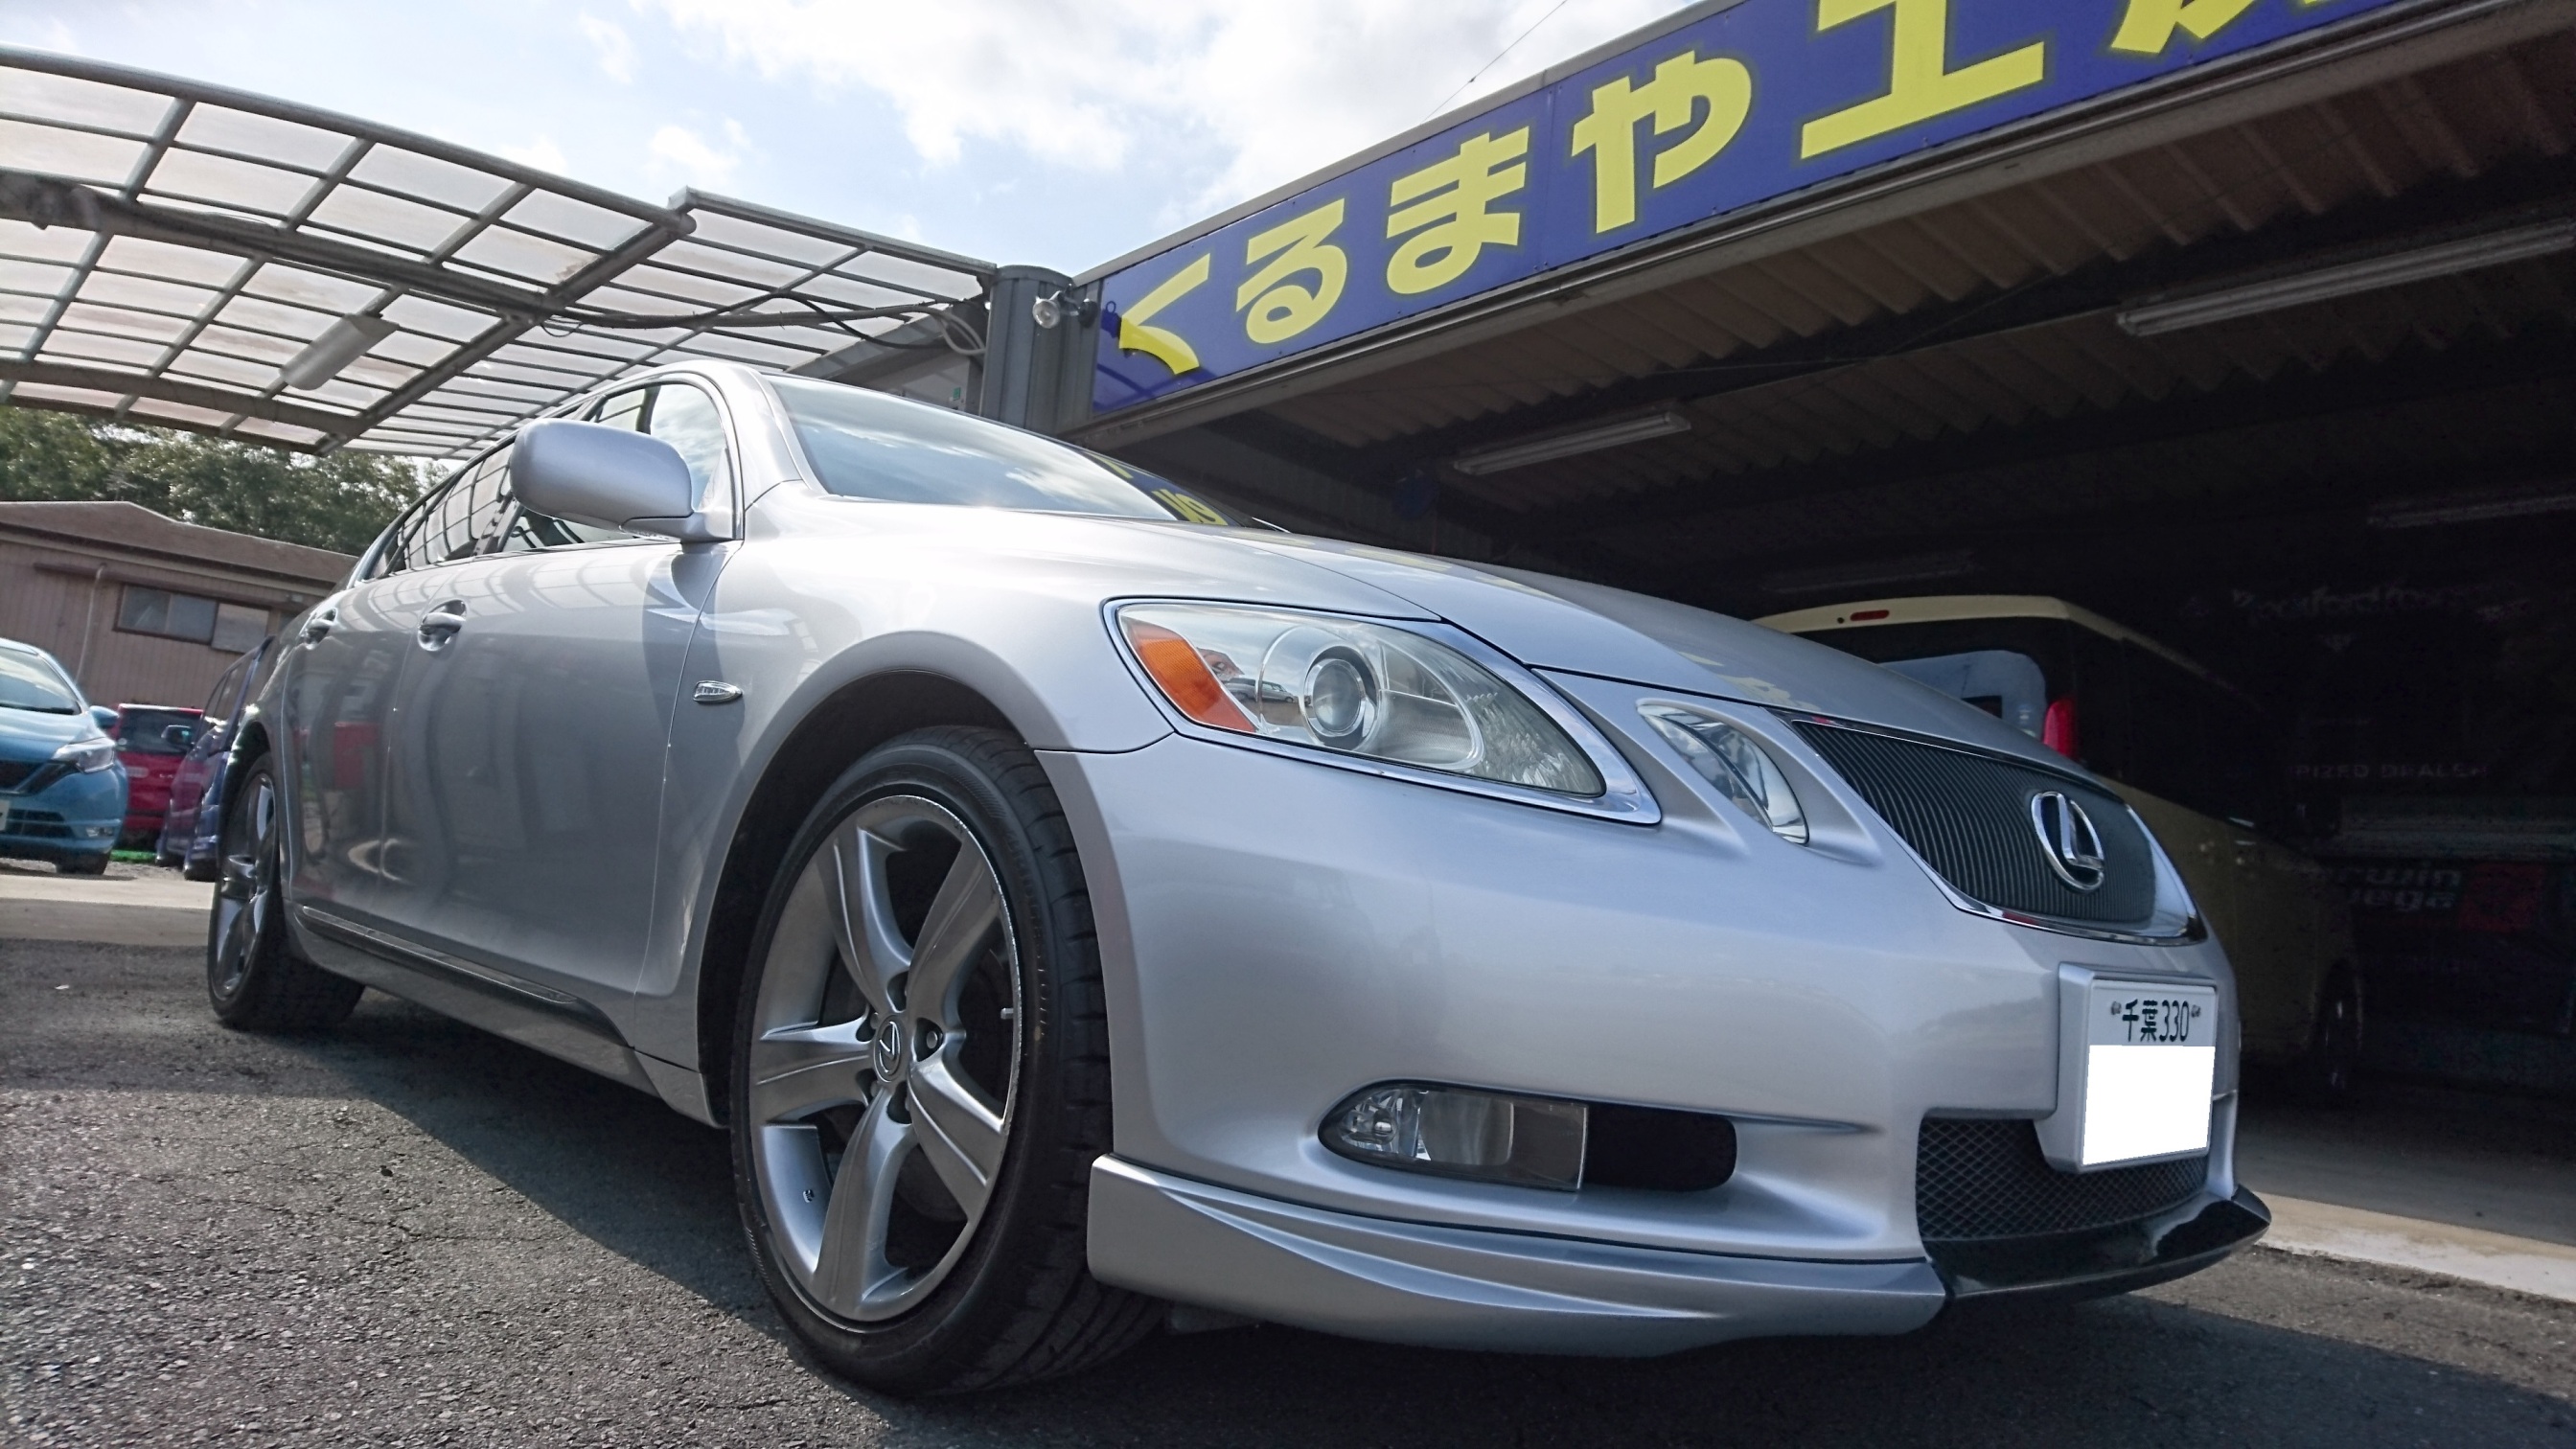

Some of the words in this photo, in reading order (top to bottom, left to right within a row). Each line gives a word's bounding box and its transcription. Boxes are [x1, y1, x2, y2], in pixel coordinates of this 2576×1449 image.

[1118, 0, 2320, 376] くるまや工
